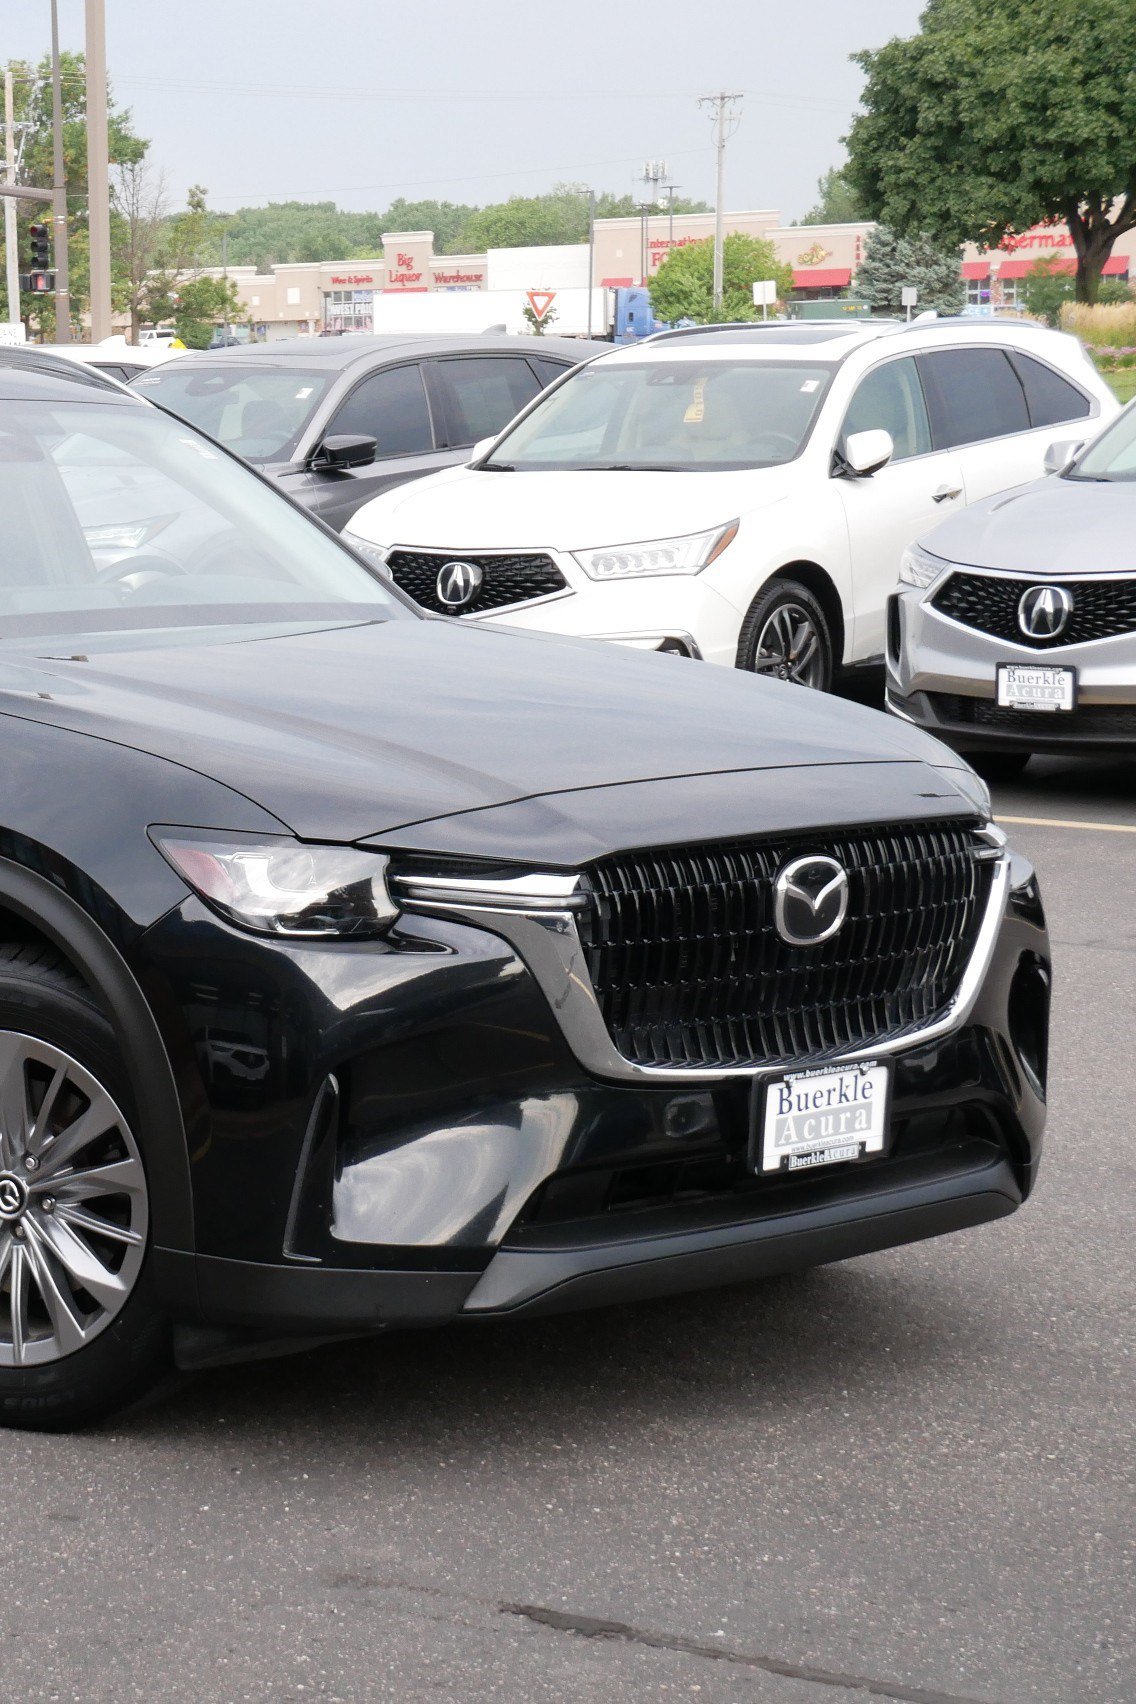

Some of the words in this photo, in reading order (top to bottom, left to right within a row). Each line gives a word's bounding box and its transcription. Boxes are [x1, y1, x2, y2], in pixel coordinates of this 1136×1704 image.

[397, 253, 413, 270] Big
[389, 270, 422, 286] Liquor
[433, 270, 483, 283] Warehouse
[1007, 670, 1065, 686] Buerkle
[1008, 684, 1063, 699] Acura
[783, 1060, 878, 1082] www.buerkleacura.com
[776, 1074, 873, 1116] Buerkle
[778, 1108, 868, 1145] Acura
